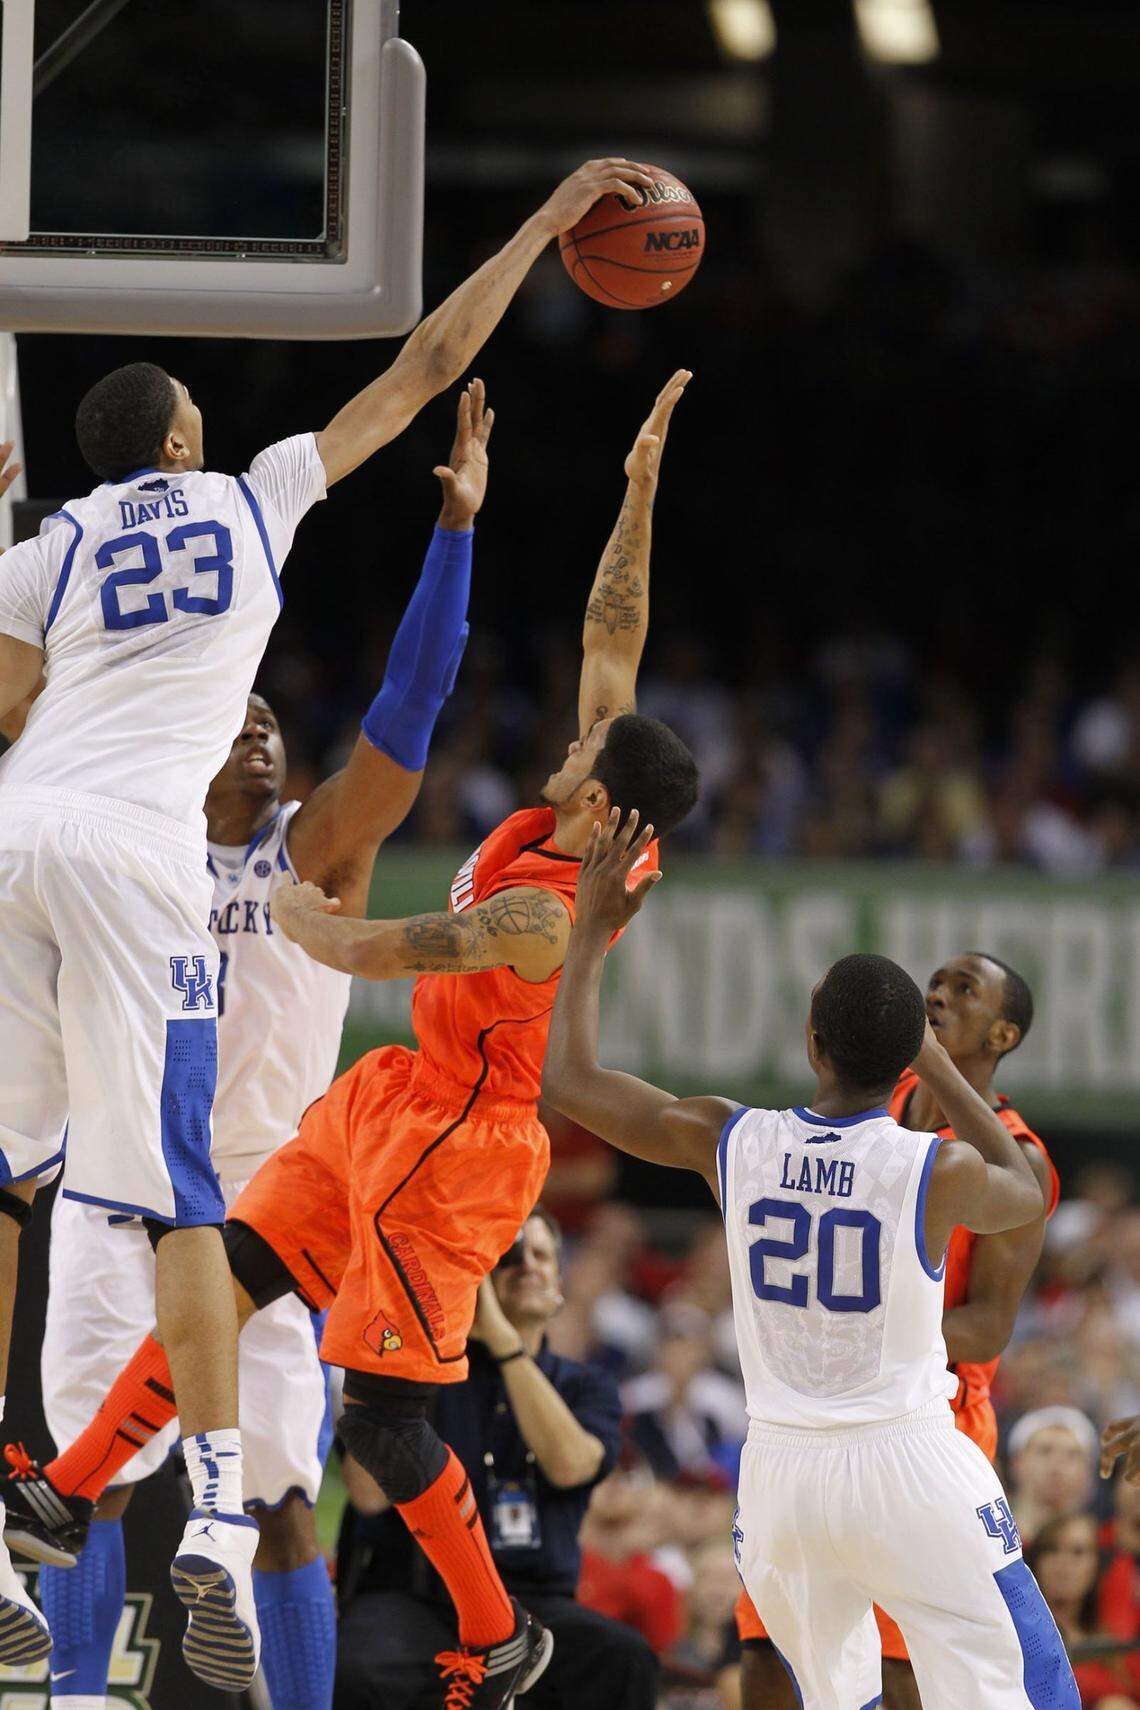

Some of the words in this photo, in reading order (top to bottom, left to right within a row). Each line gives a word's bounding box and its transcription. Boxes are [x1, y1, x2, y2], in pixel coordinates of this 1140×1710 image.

[644, 228, 700, 252] NCAA
[119, 489, 189, 530] DAVIS
[94, 520, 234, 630] 23
[170, 955, 215, 1011] UK
[779, 1152, 856, 1198] LAMB
[748, 1196, 882, 1314] 20
[388, 1231, 446, 1342] CARDINALS
